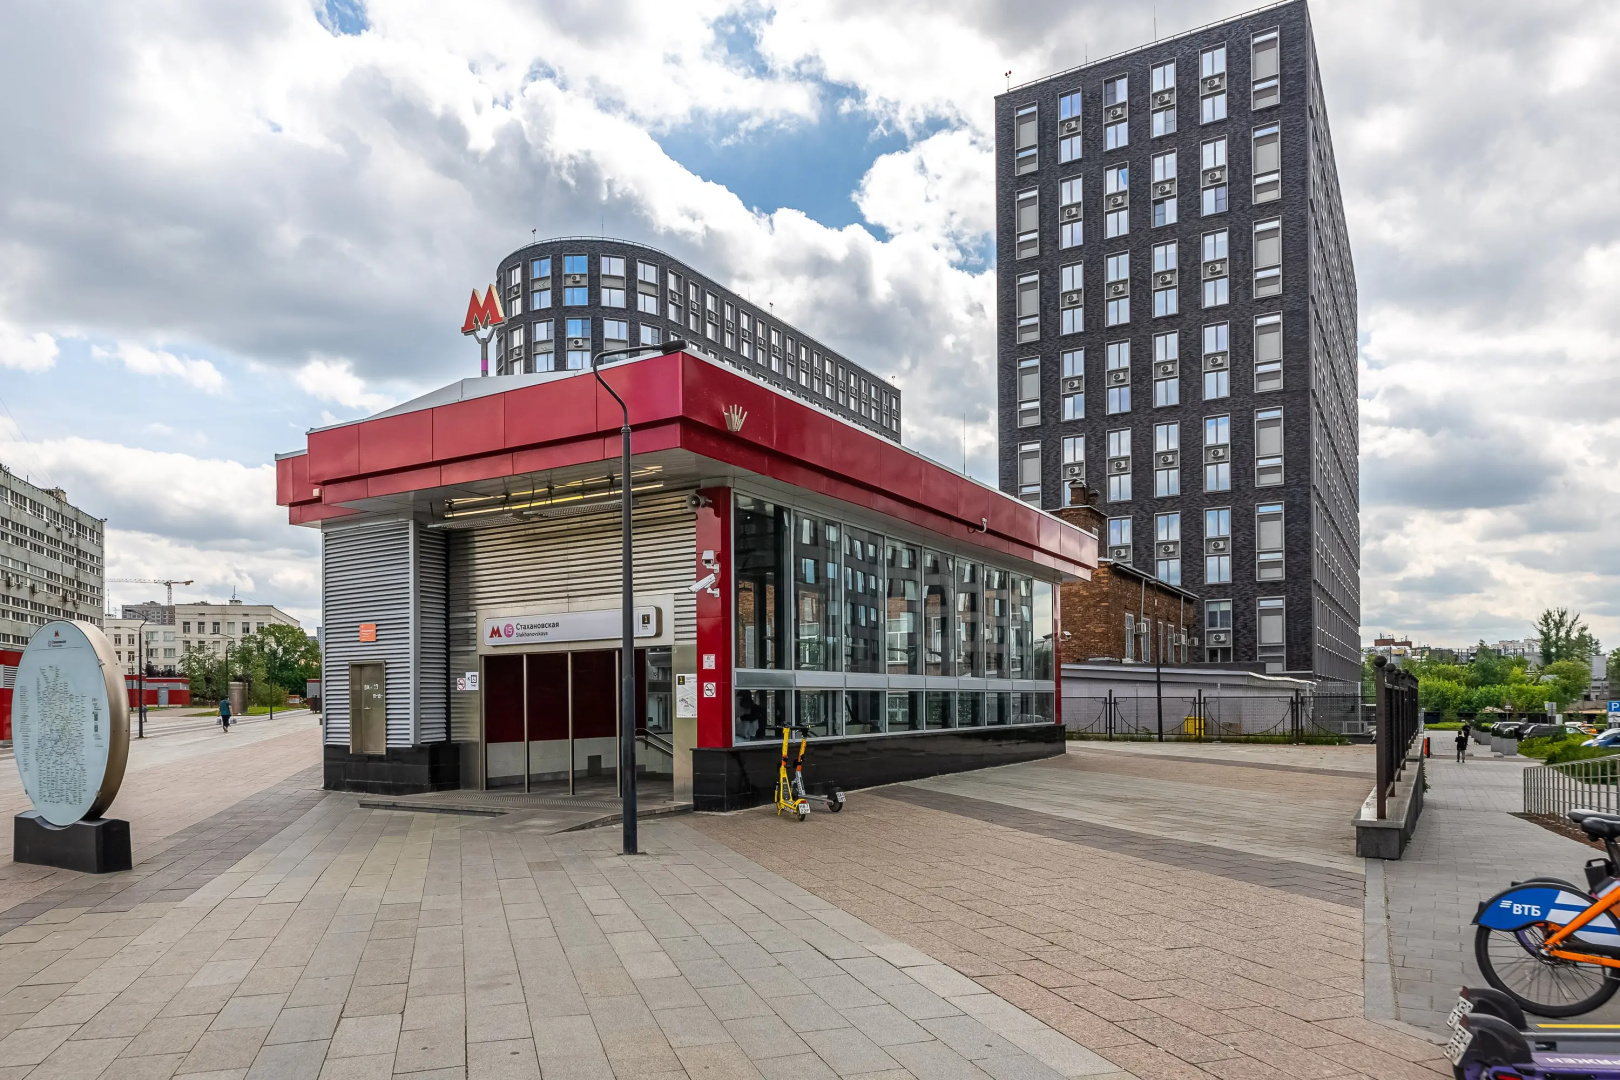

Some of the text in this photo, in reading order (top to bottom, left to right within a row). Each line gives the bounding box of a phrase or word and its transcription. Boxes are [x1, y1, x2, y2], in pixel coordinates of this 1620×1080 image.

[515, 622, 560, 631] Стахановская
[1611, 702, 1620, 712] P
[1512, 903, 1541, 917] ВТБ
